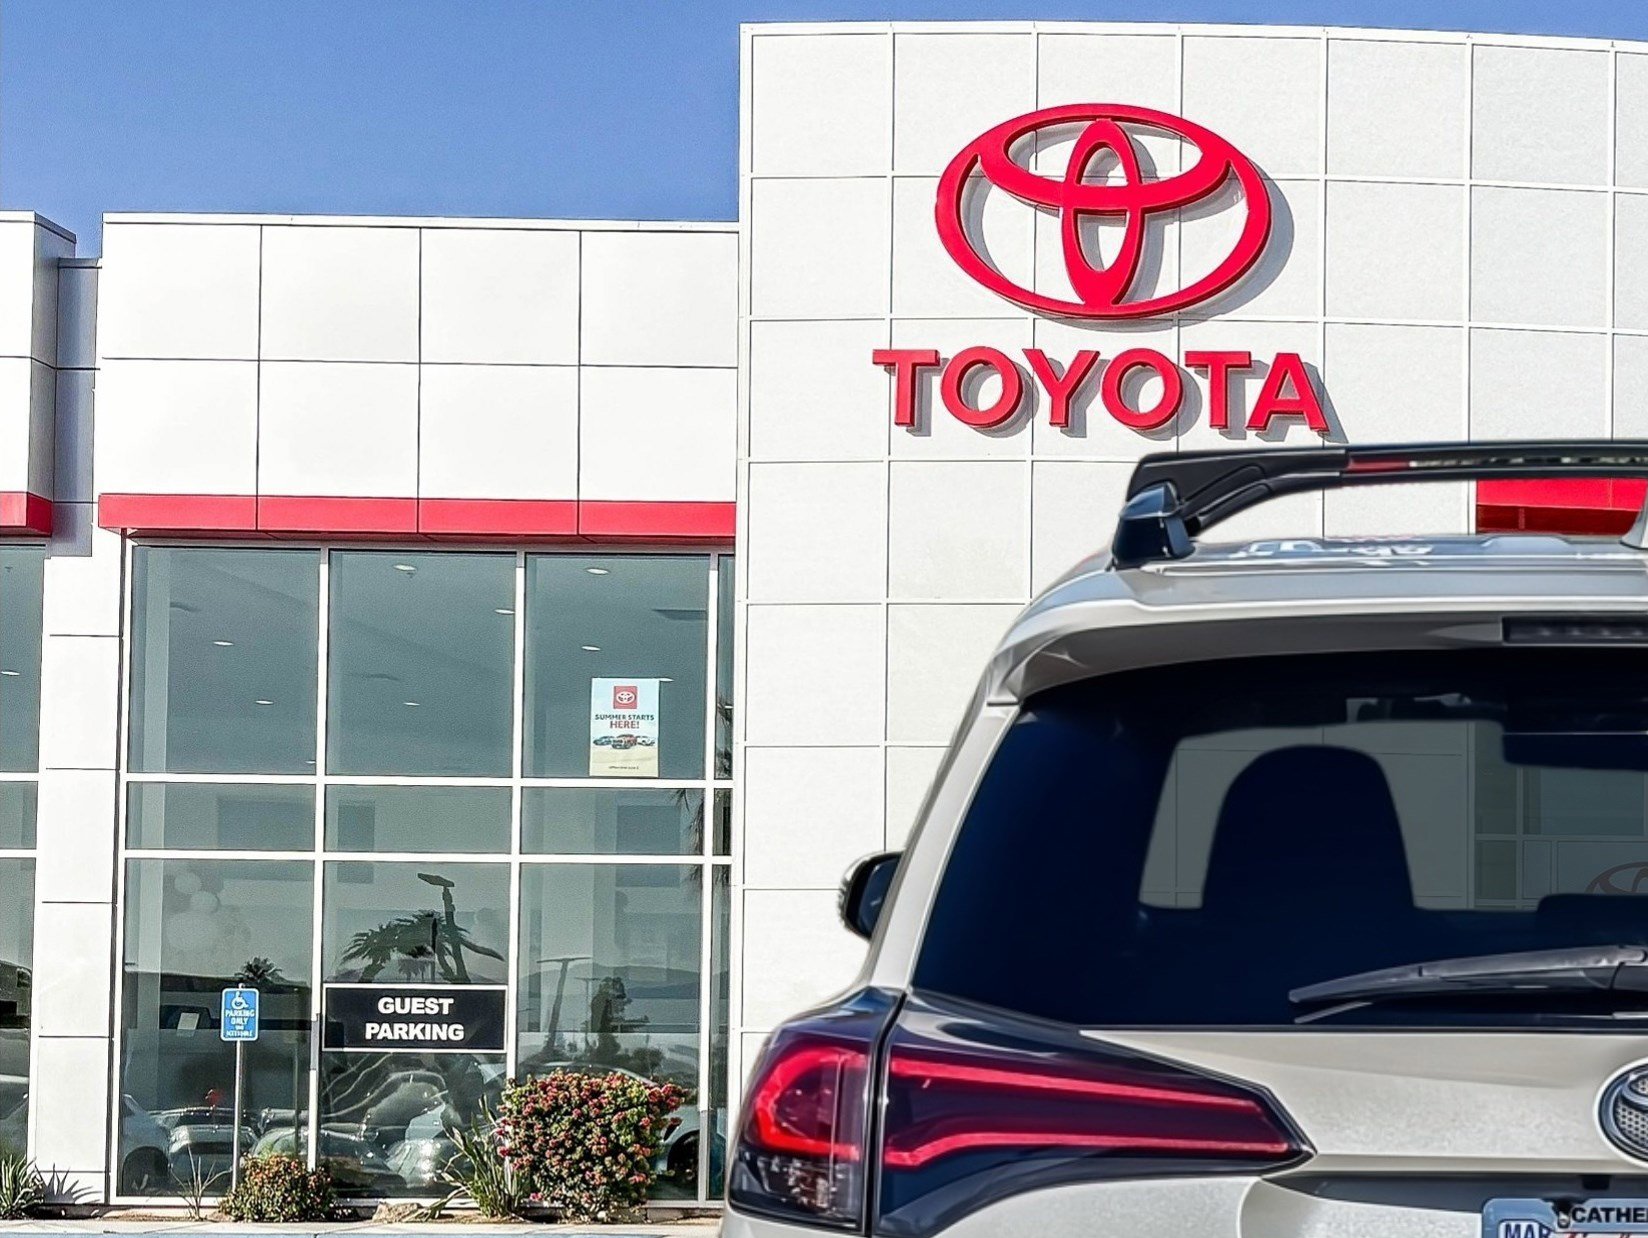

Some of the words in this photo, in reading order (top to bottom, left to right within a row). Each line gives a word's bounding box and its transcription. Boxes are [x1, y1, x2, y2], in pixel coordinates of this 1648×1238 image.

[872, 345, 1329, 432] TOYOTA
[610, 721, 640, 729] HERE!
[225, 1009, 255, 1018] PARKING
[377, 997, 455, 1015] GUEST
[365, 1023, 465, 1041] PARKING
